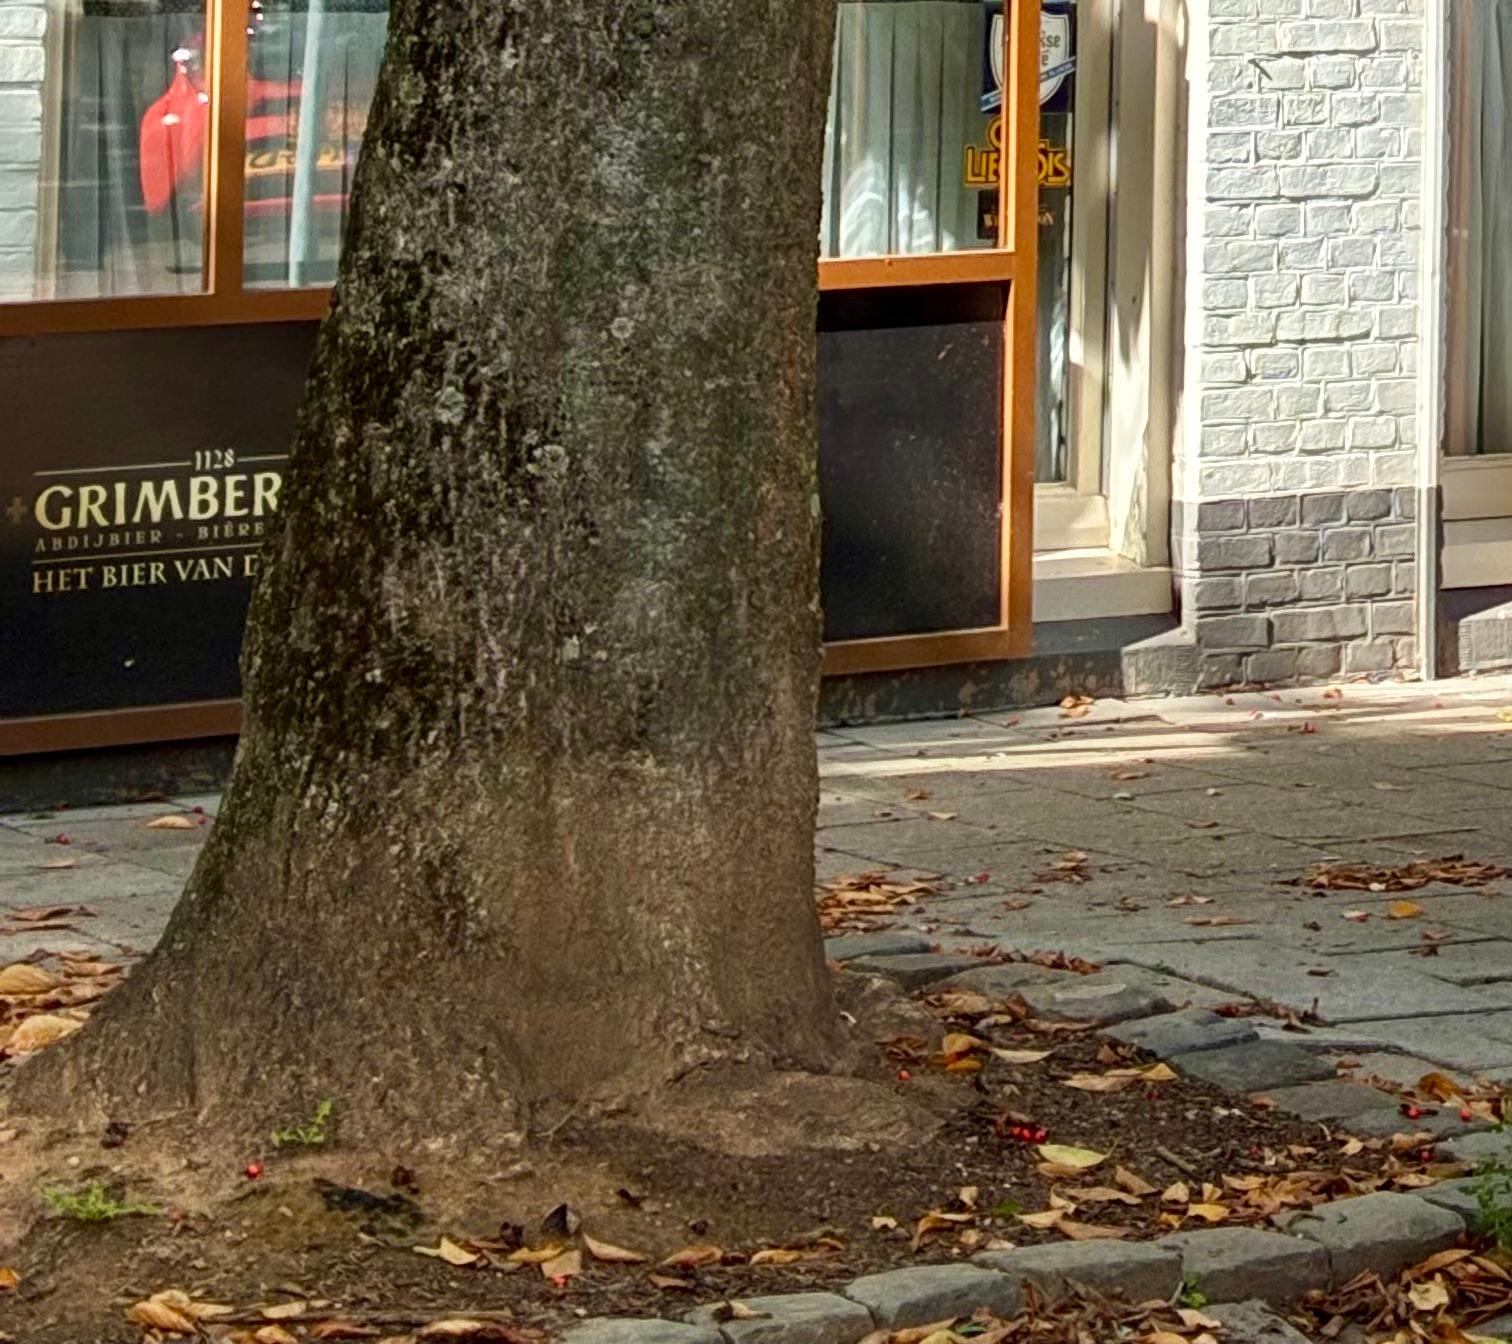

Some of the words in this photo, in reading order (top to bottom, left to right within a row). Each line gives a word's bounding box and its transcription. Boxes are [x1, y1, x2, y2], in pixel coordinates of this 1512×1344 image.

[195, 448, 235, 471] 1128
[35, 472, 282, 530] GRIMBER
[35, 529, 163, 553] ABDIJBIER
[33, 566, 94, 593] HET
[102, 561, 168, 588] BIER
[175, 556, 234, 581] VAN
